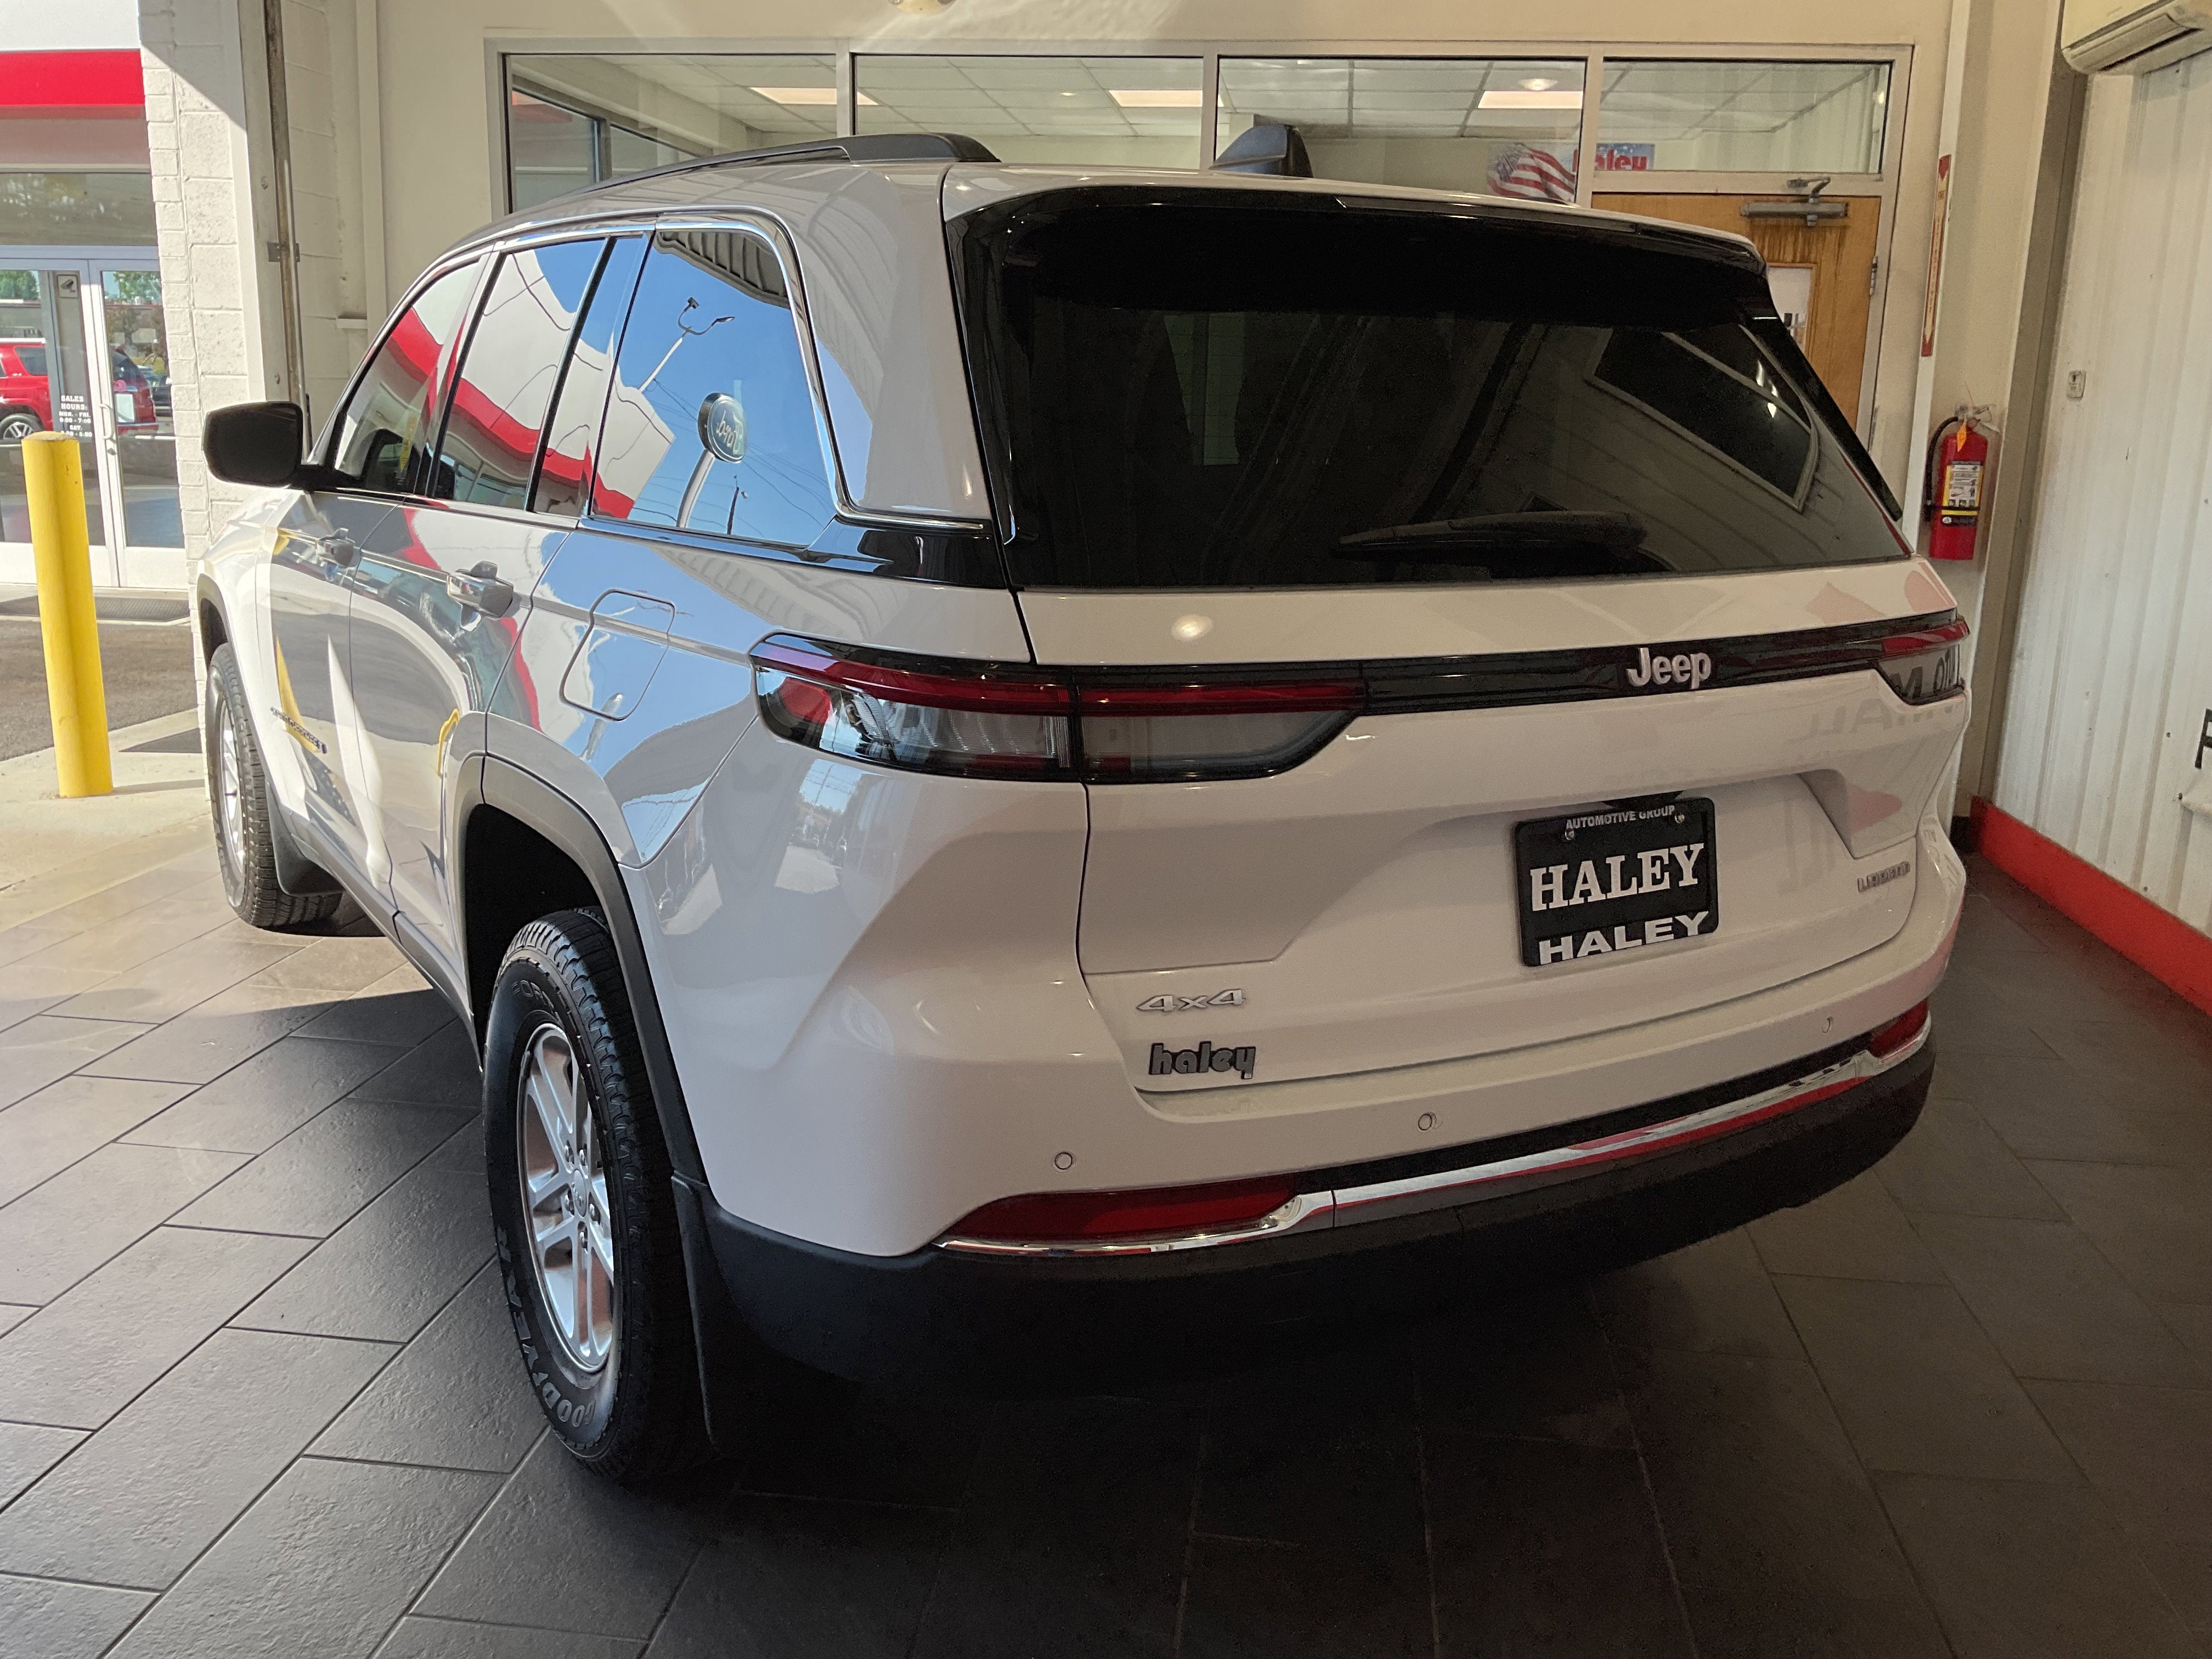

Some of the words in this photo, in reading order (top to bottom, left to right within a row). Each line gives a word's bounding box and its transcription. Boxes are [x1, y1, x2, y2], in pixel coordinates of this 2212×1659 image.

[1626, 647, 1712, 690] Jeep
[1565, 810, 1637, 830] AUTOMOTIVE
[1638, 804, 1676, 820] GROUP
[1530, 843, 1705, 911] HALEY
[1538, 911, 1709, 965] HALEY
[1136, 988, 1247, 1012] 4x4
[1148, 1041, 1256, 1080] haley
